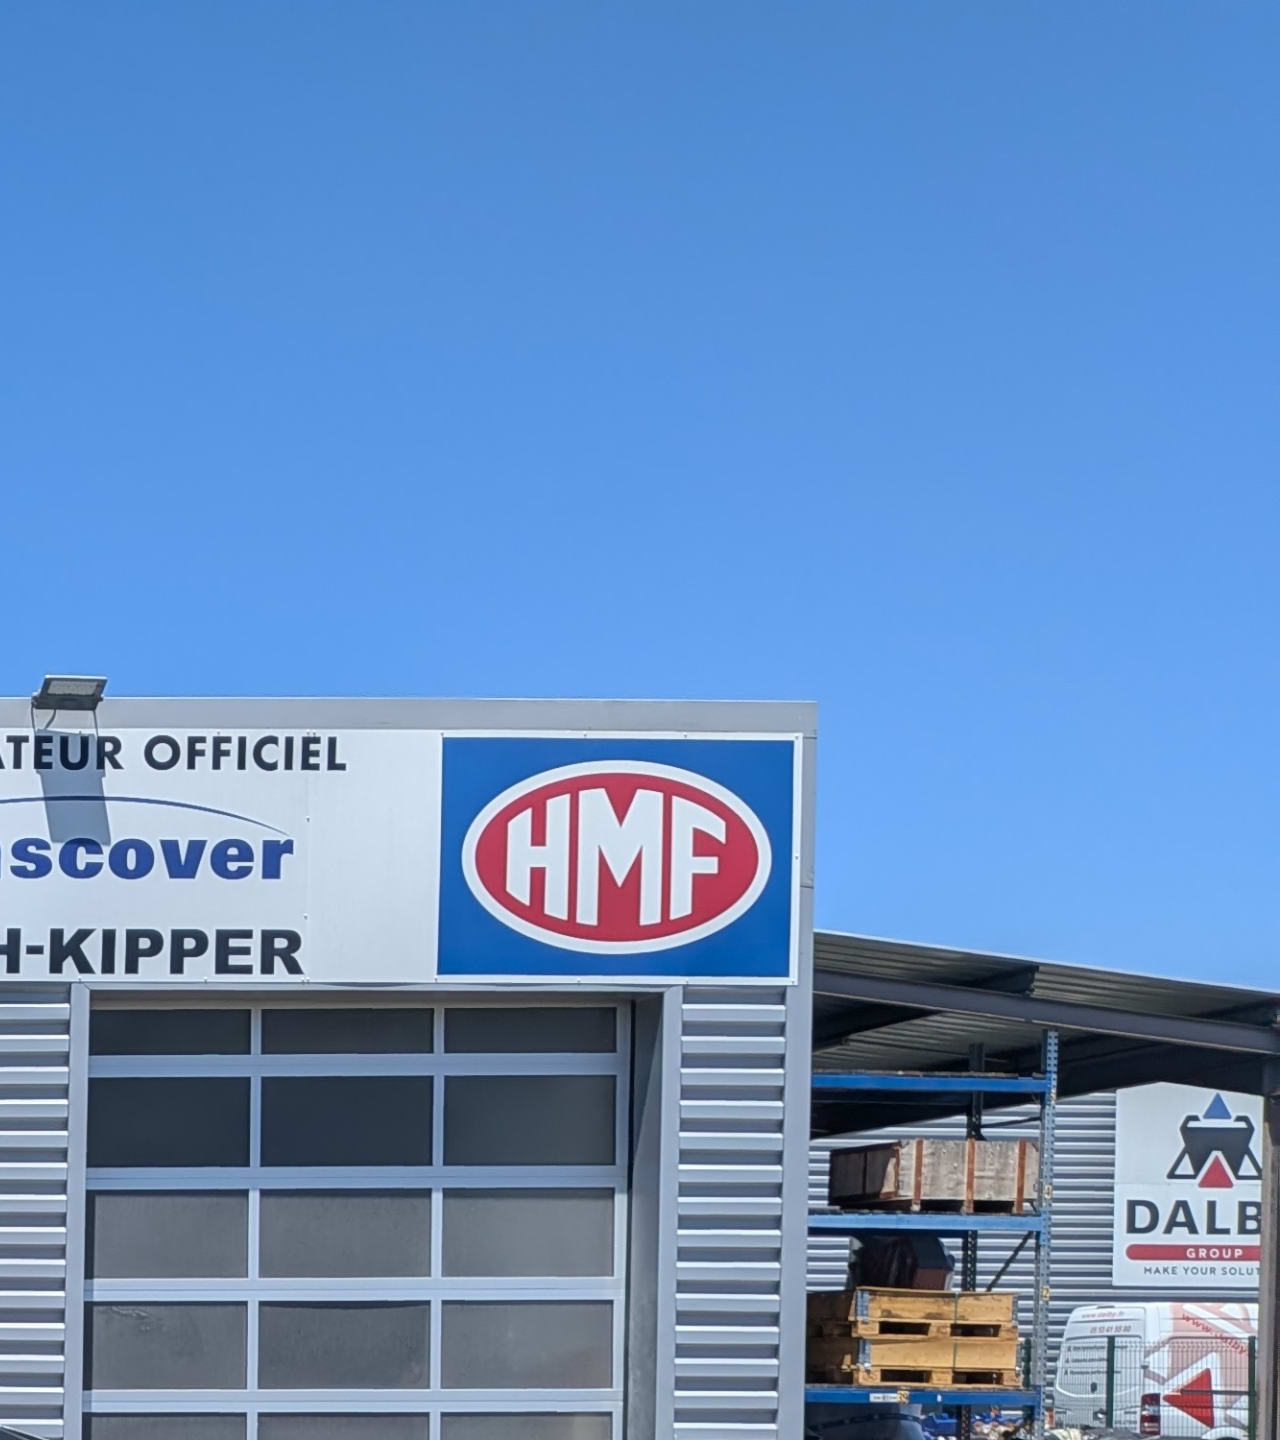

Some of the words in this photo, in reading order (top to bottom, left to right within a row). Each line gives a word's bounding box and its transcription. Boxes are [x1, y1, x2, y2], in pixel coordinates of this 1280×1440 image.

[143, 734, 347, 772] OFFICIEL
[504, 787, 727, 927] HMF
[1125, 1199, 1262, 1235] DALB
[1143, 1266, 1178, 1275] MAKE
[1183, 1266, 1216, 1275] YOUR
[1186, 1248, 1244, 1259] GROUP
